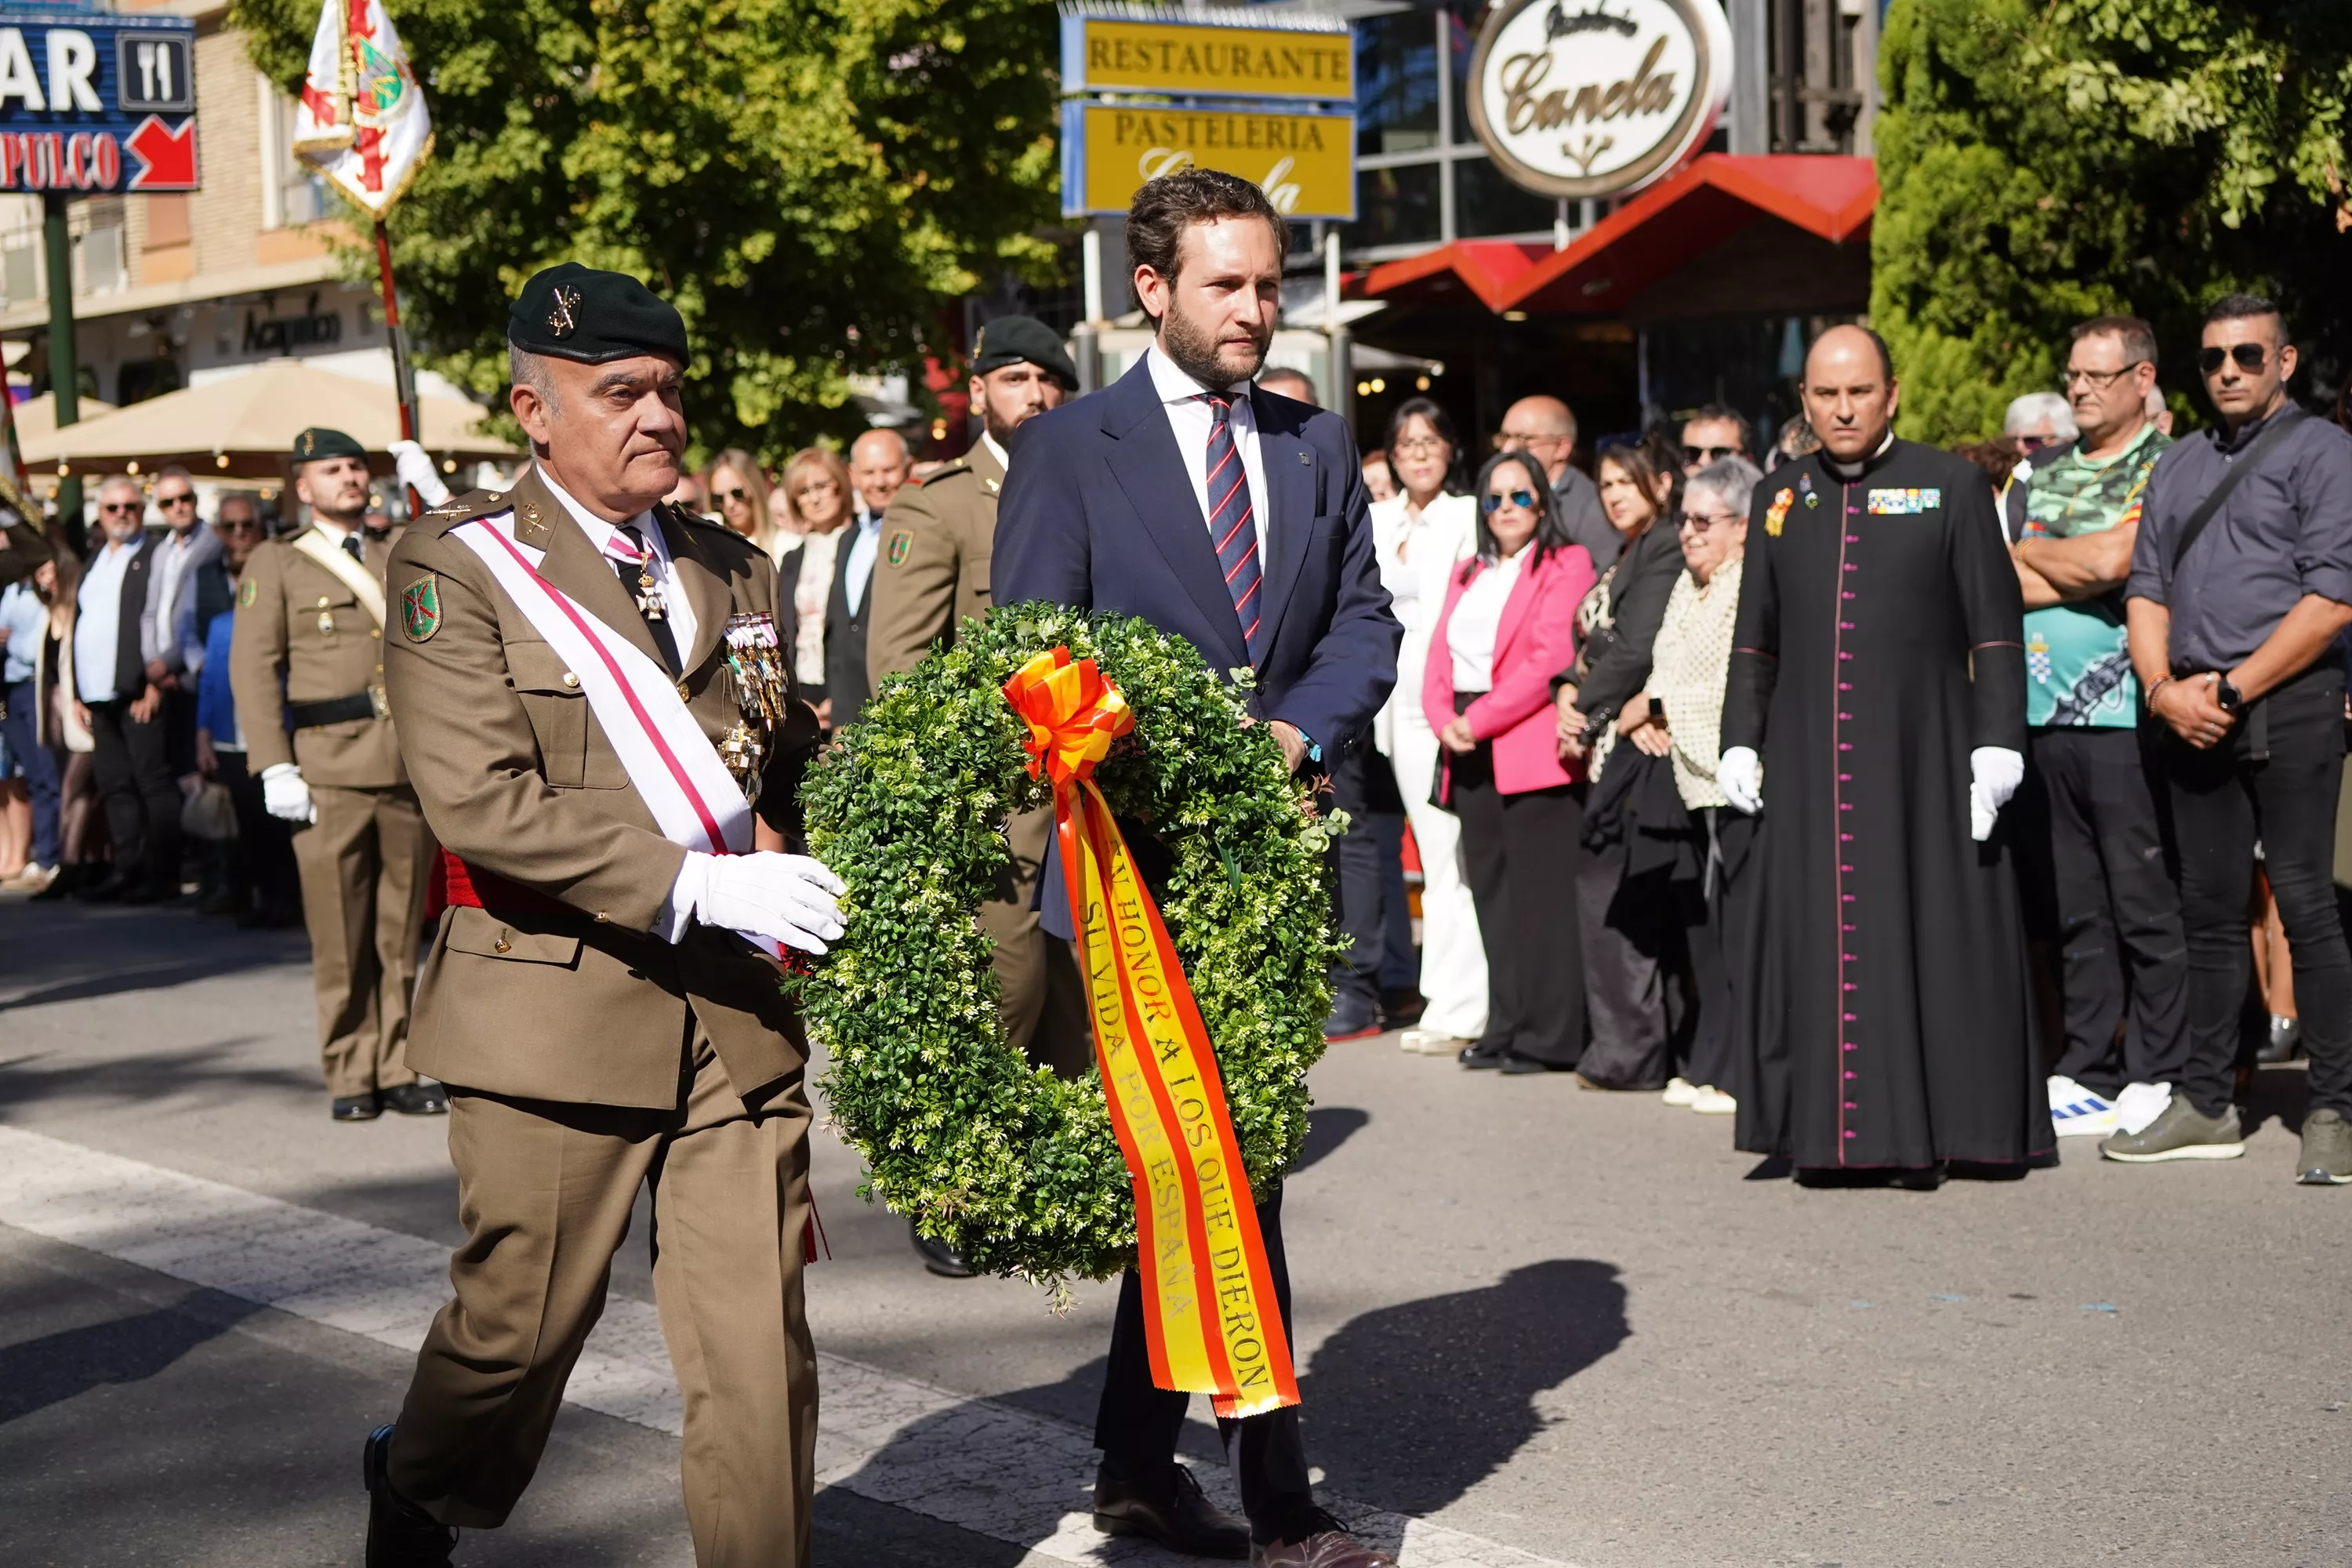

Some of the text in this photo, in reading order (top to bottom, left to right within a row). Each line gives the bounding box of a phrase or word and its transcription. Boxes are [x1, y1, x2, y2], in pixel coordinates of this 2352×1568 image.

[0, 27, 103, 111] AR
[1091, 37, 1348, 82] RESTAURANTE
[1501, 34, 1676, 135] Canela
[0, 132, 120, 190] PULCO
[1079, 901, 1109, 949] SU
[1117, 898, 1171, 1028] HONOR
[1092, 960, 1126, 1061] VIDA
[1154, 1037, 1185, 1068] A
[1119, 1069, 1160, 1149] POR
[1168, 1073, 1213, 1150] LOS
[1196, 1157, 1233, 1238] QUE
[1212, 1245, 1269, 1389] DIERON
